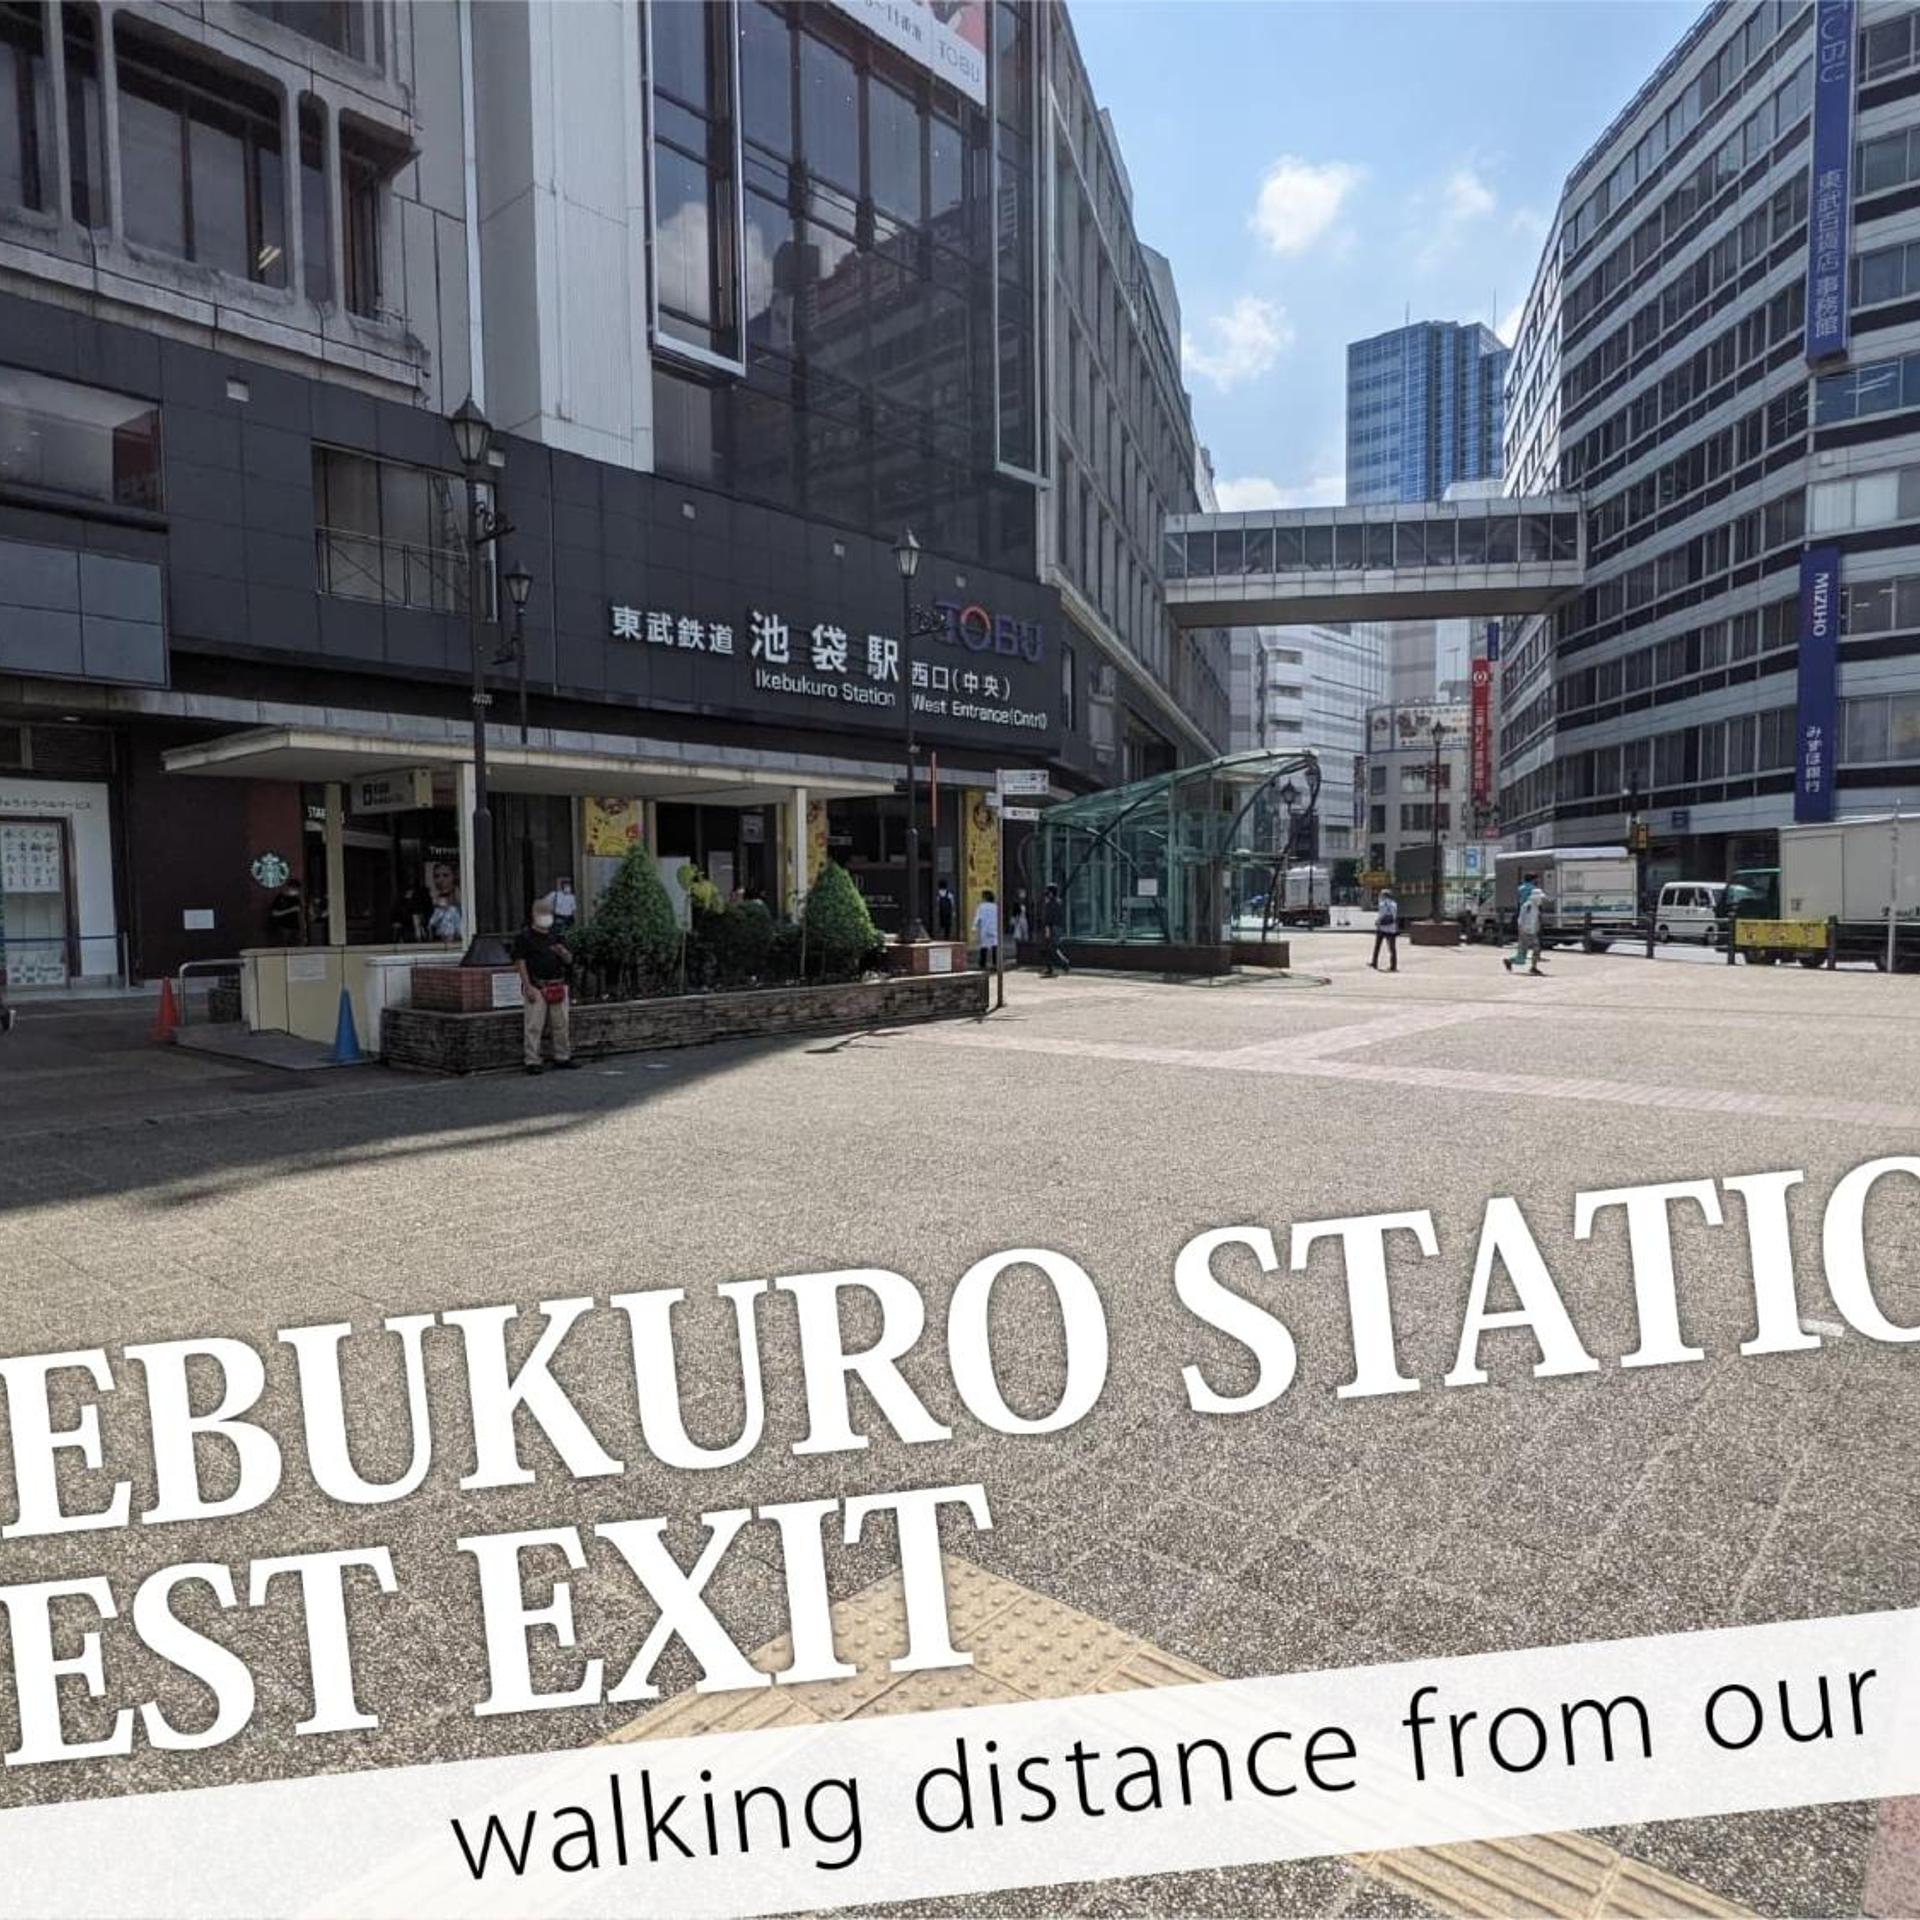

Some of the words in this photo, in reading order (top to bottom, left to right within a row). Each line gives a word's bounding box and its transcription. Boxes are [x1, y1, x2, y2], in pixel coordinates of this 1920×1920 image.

[938, 40, 980, 83] TOBU
[935, 601, 1043, 663] TOBU
[1813, 573, 1829, 637] MIZUHO
[611, 605, 734, 656] 東武鉄道
[751, 610, 899, 683] 池袋駅
[755, 668, 838, 698] Ikebukuro
[842, 682, 896, 707] Station
[911, 693, 947, 715] West
